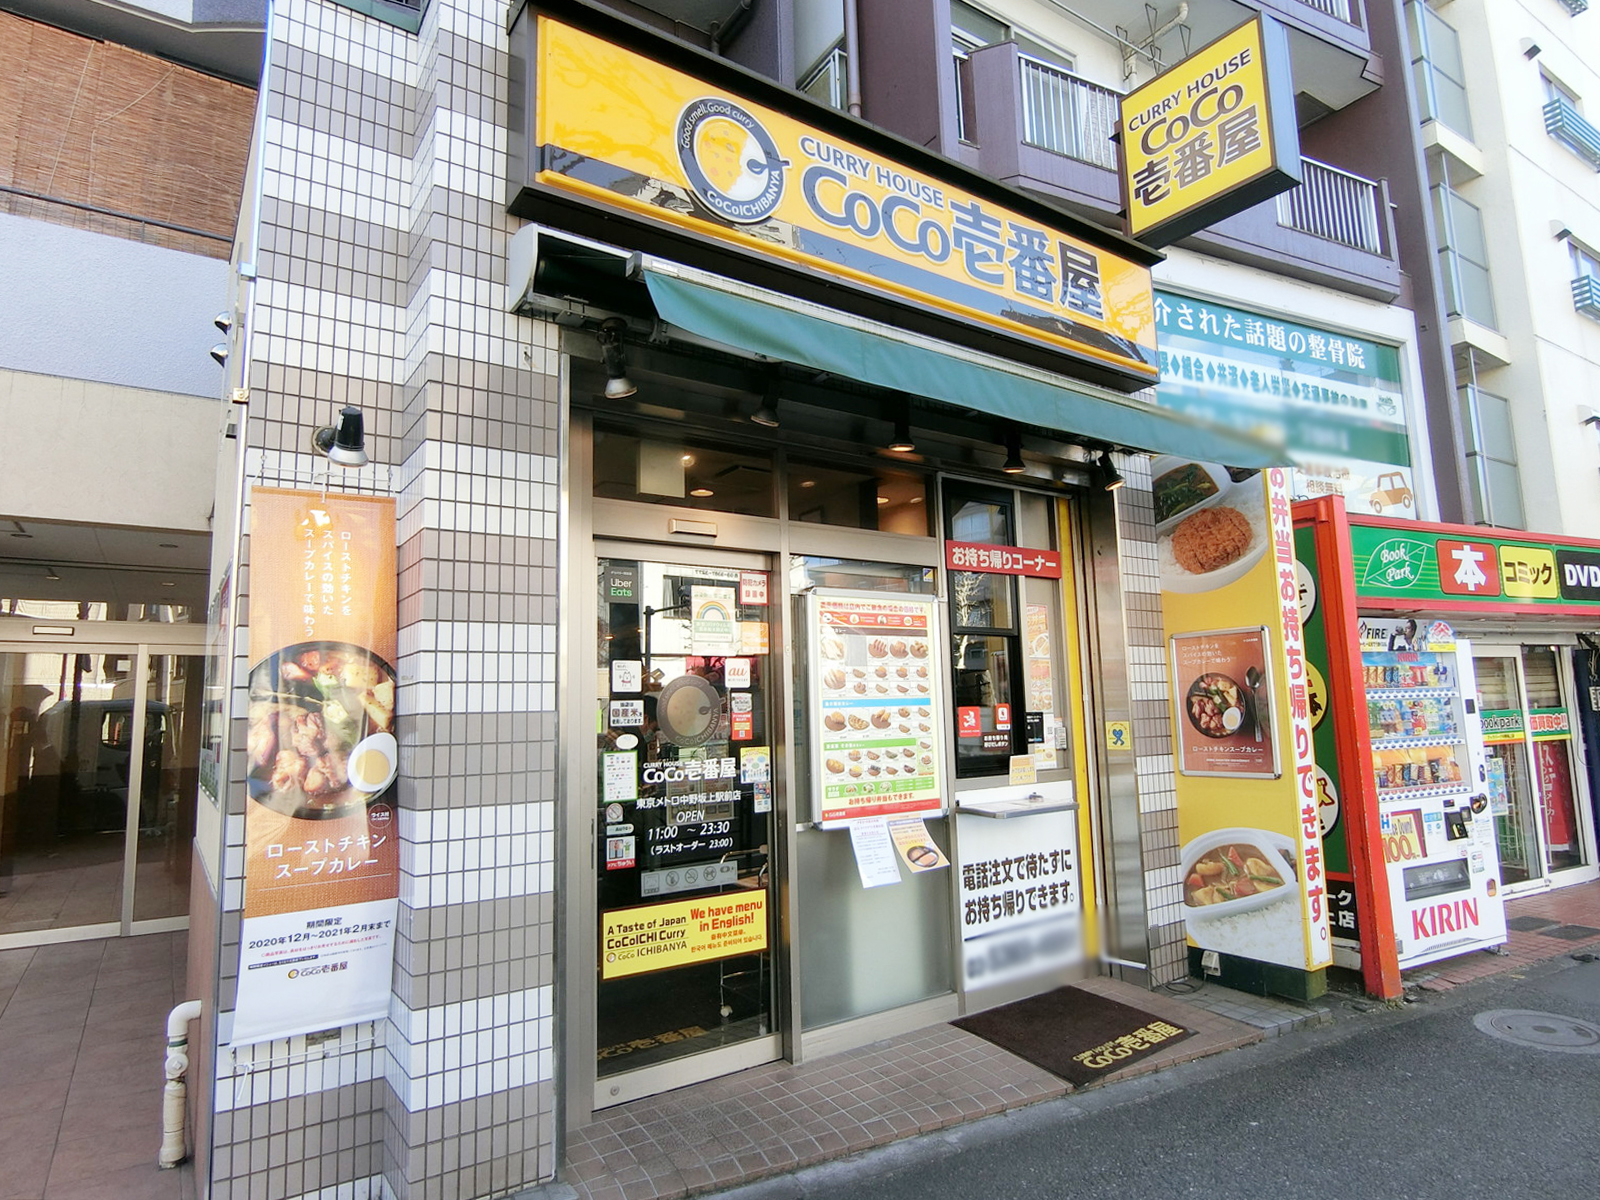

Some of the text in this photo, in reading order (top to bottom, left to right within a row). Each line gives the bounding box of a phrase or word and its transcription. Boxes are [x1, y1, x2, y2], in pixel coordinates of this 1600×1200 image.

[1129, 48, 1251, 132] CURRY HOUSE
[707, 102, 731, 115] Good
[1141, 84, 1243, 155] CoCo
[1133, 105, 1261, 206] 壱番屋
[800, 136, 944, 209] CURRY HOUSE
[1155, 296, 1366, 370] 介された話題の整骨院
[952, 546, 1057, 572] お持ち帰りコーナー
[1380, 543, 1409, 564] Book
[1386, 562, 1414, 582] Park
[1451, 545, 1487, 591] 本
[1504, 560, 1551, 585] コミック
[610, 578, 632, 587] Uber
[611, 588, 632, 597] Eats
[1366, 628, 1387, 639] FIRE
[728, 667, 747, 677] au
[643, 757, 737, 784] CoCo壱番屋
[635, 790, 741, 810] 東京メトロ中野坂上駅前店
[676, 810, 705, 823] OPEN
[648, 825, 679, 841] 11:00
[700, 821, 730, 836] 23:30
[266, 833, 387, 859] ローストチキン
[275, 858, 379, 880] スープカレー
[962, 849, 1072, 892] 電話注文で待たずに
[690, 901, 763, 920] We have menu
[964, 880, 1075, 926] お持ち帰りできます。
[306, 917, 343, 930] 期間限定
[608, 916, 686, 935] A Taste of Japan
[700, 912, 754, 932] in English!
[1411, 898, 1480, 940] KIRIN
[607, 929, 686, 950] CoCoICHI Curry
[637, 941, 687, 957] ICHIBANYA
